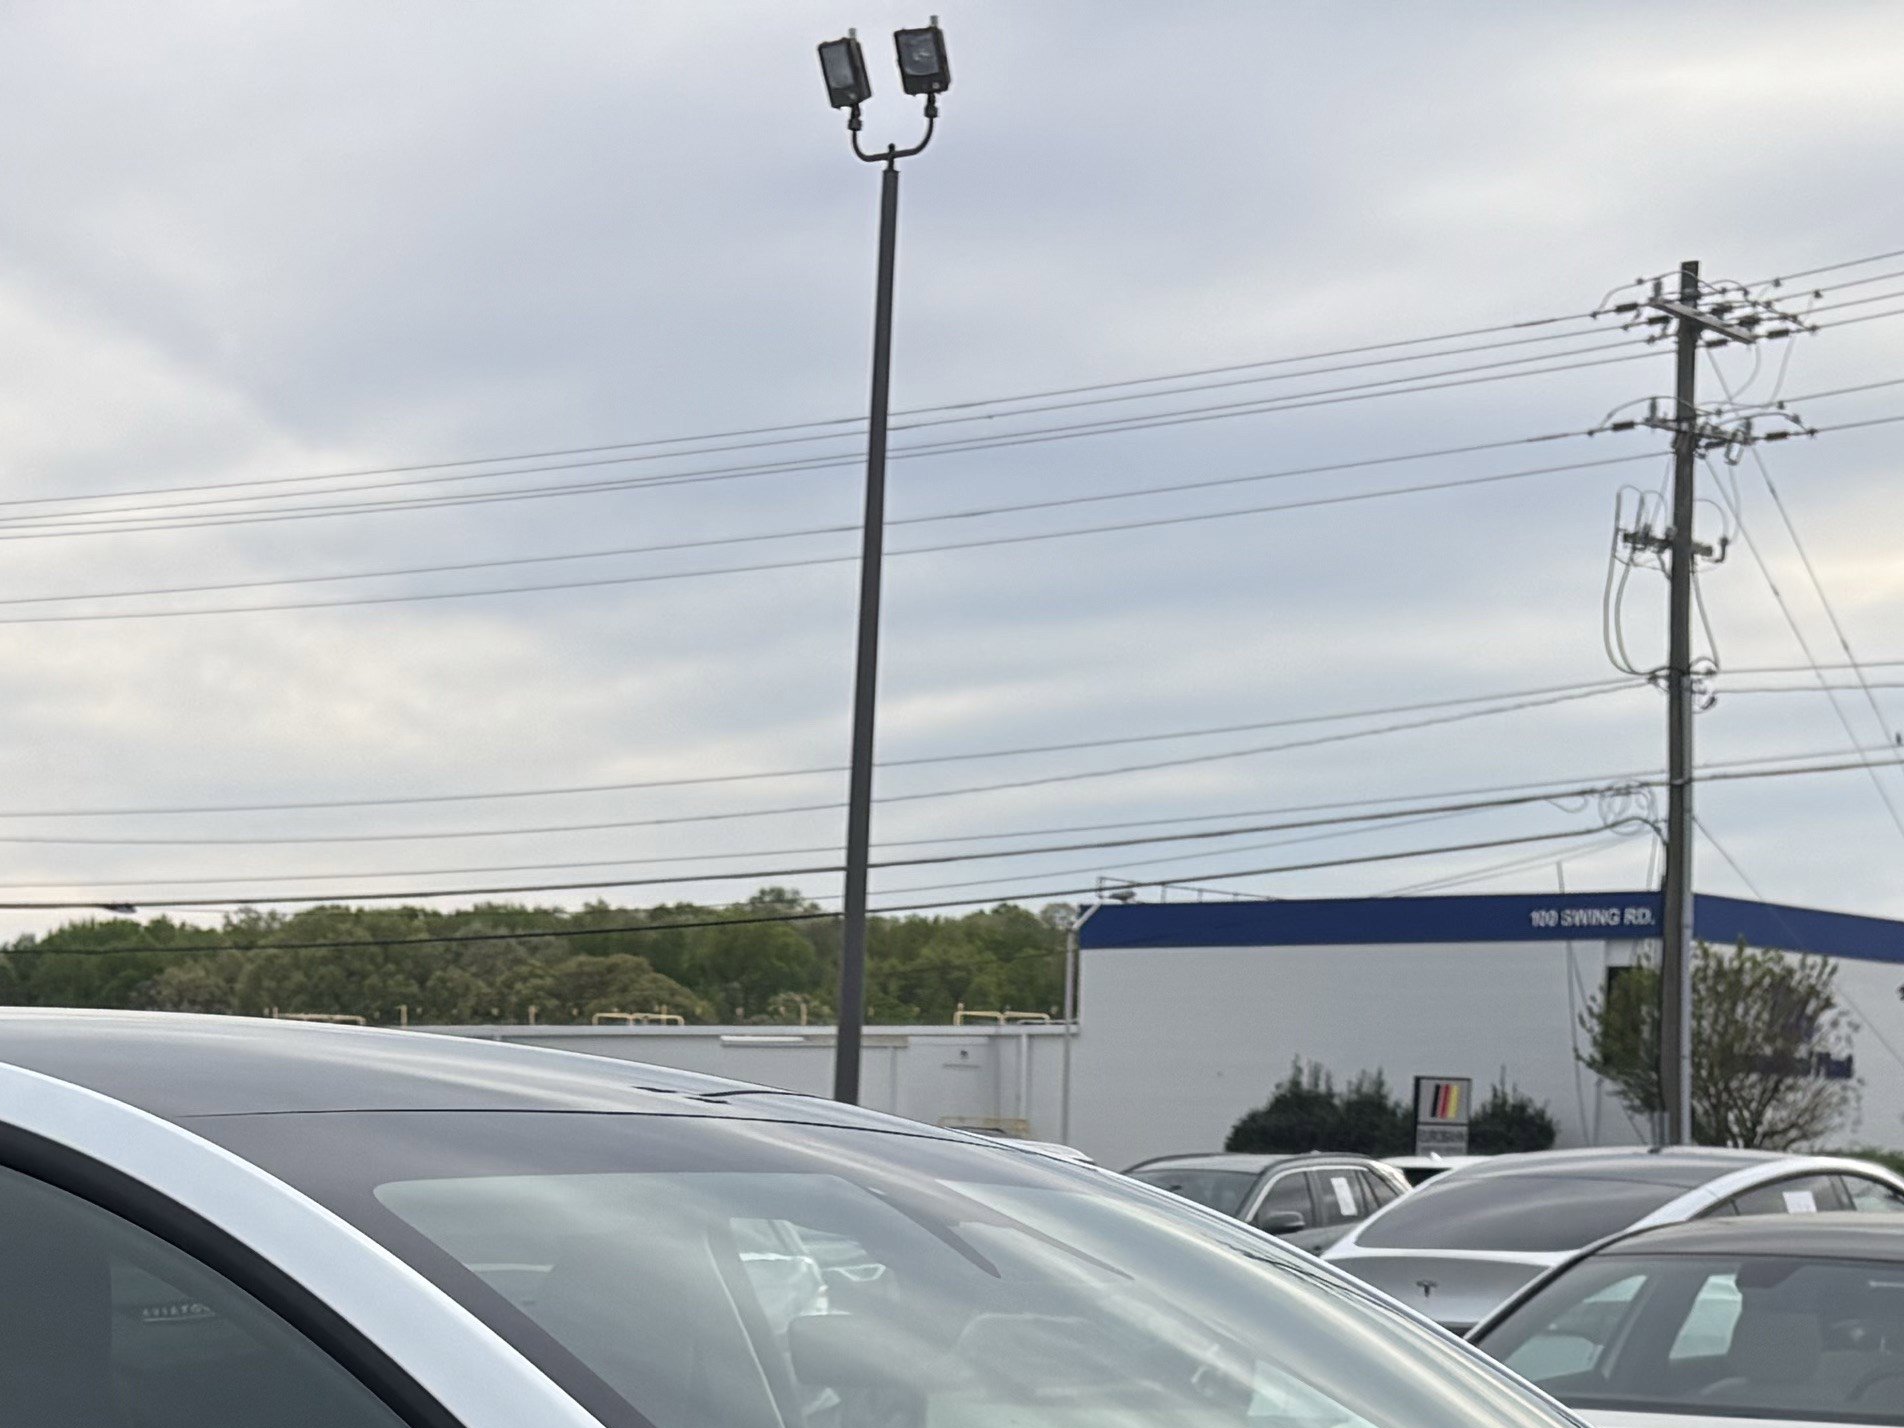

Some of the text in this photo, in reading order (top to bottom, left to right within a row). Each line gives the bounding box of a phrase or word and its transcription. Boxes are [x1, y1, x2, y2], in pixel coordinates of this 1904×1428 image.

[1528, 907, 1656, 927] 100 SWING RD.
